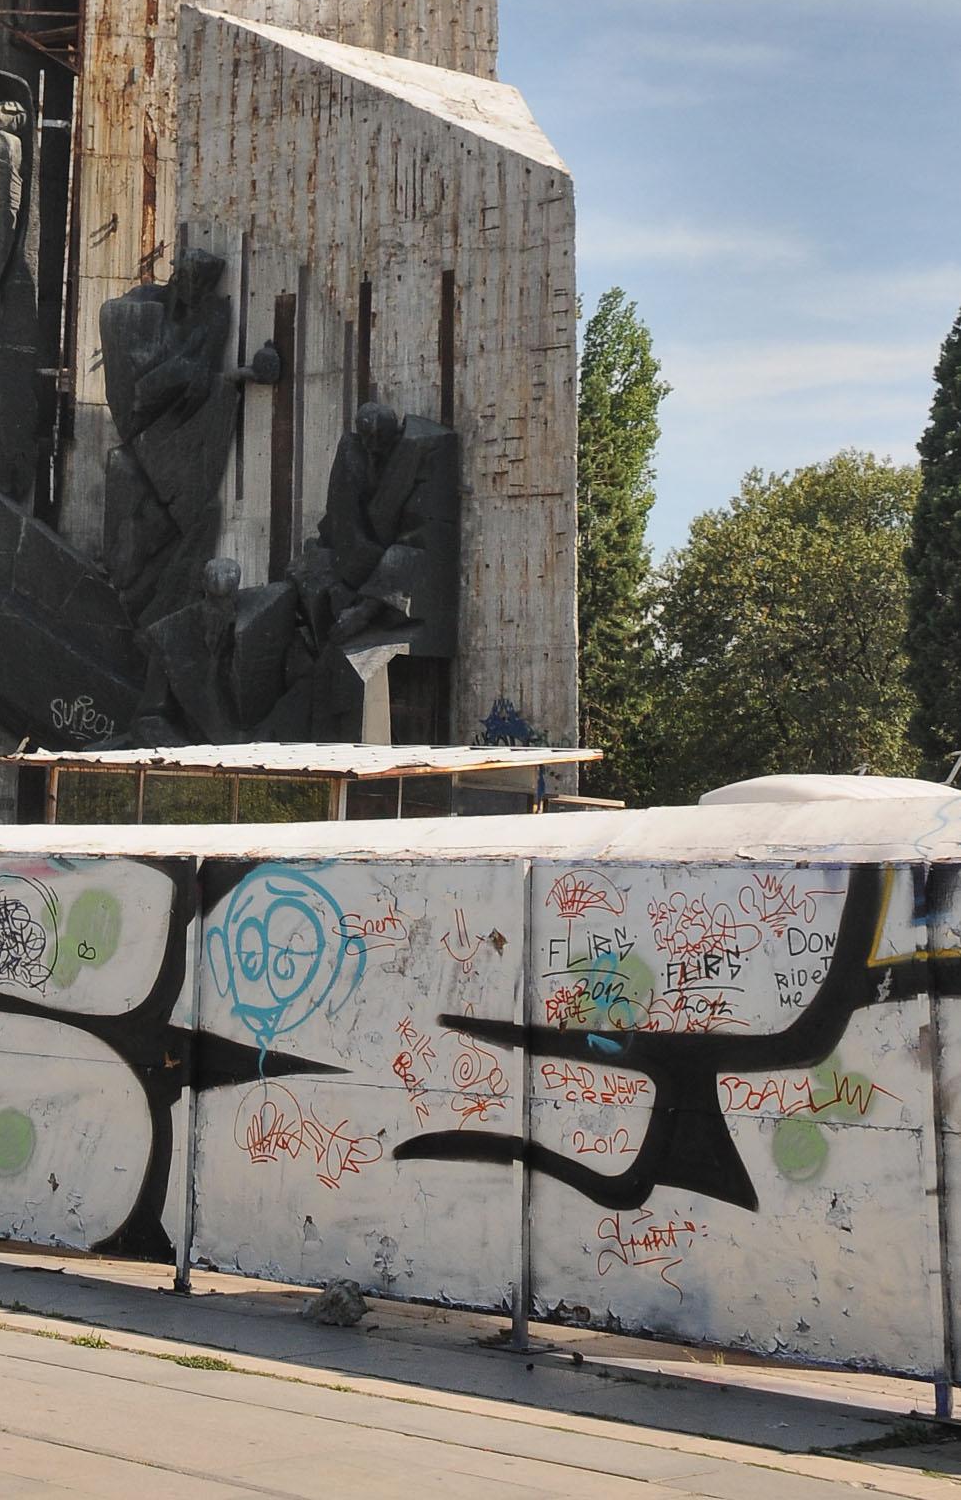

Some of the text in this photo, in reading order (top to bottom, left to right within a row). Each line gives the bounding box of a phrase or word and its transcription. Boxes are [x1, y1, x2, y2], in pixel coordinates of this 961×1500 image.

[787, 927, 836, 956] DON
[572, 977, 630, 1005] 2012
[541, 1063, 595, 1090] BAD
[565, 1088, 635, 1106] CREW
[572, 1128, 639, 1155] 2012
